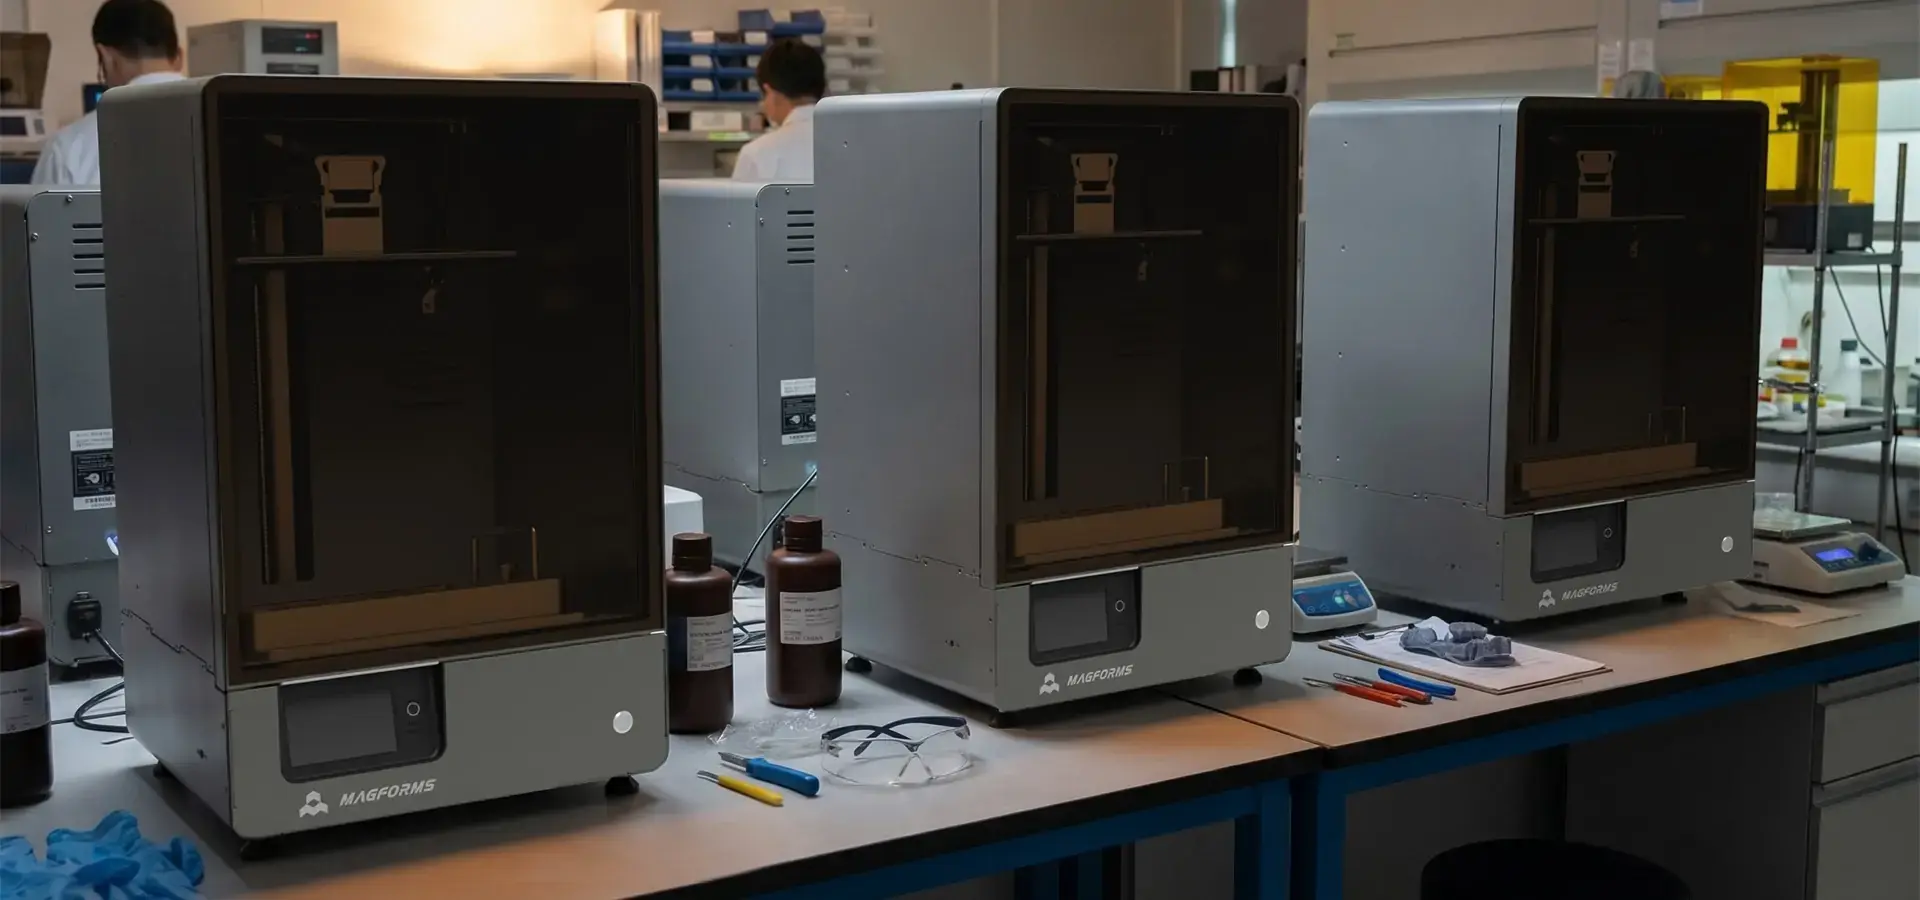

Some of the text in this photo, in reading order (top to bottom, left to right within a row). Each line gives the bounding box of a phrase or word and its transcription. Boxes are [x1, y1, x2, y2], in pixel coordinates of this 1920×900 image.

[1561, 581, 1619, 601] MAGFORMS
[1067, 664, 1133, 686] MAGFORMS
[339, 779, 437, 807] MAGFORMS
